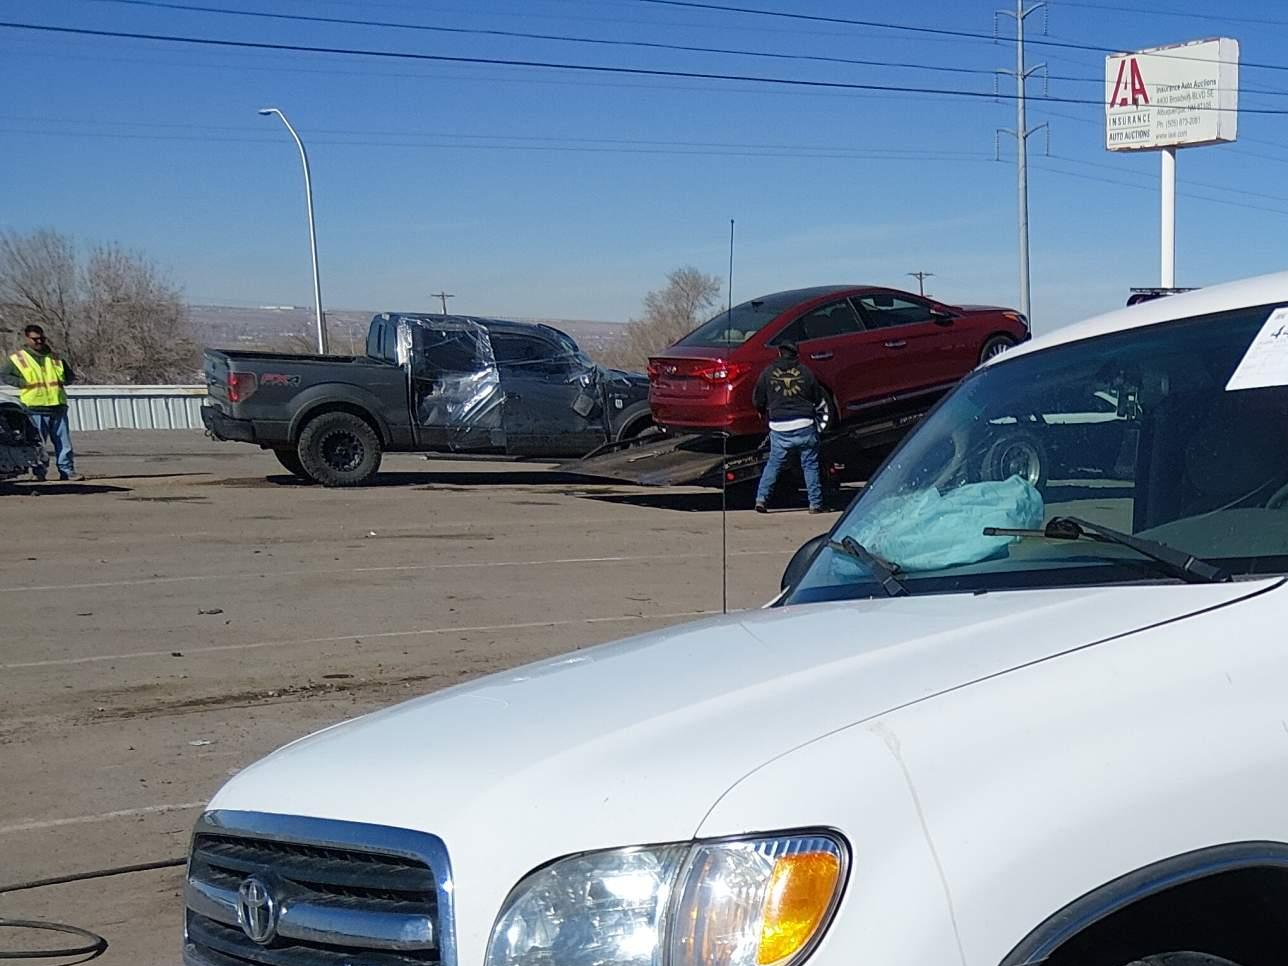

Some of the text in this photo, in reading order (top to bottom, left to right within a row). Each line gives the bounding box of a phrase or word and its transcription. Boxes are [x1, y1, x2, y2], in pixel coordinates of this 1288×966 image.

[1181, 81, 1193, 90] Auto
[1193, 79, 1216, 88] Auctions
[1109, 113, 1150, 127] INSURANCE
[1109, 129, 1150, 141] AUTO AUCTIONS
